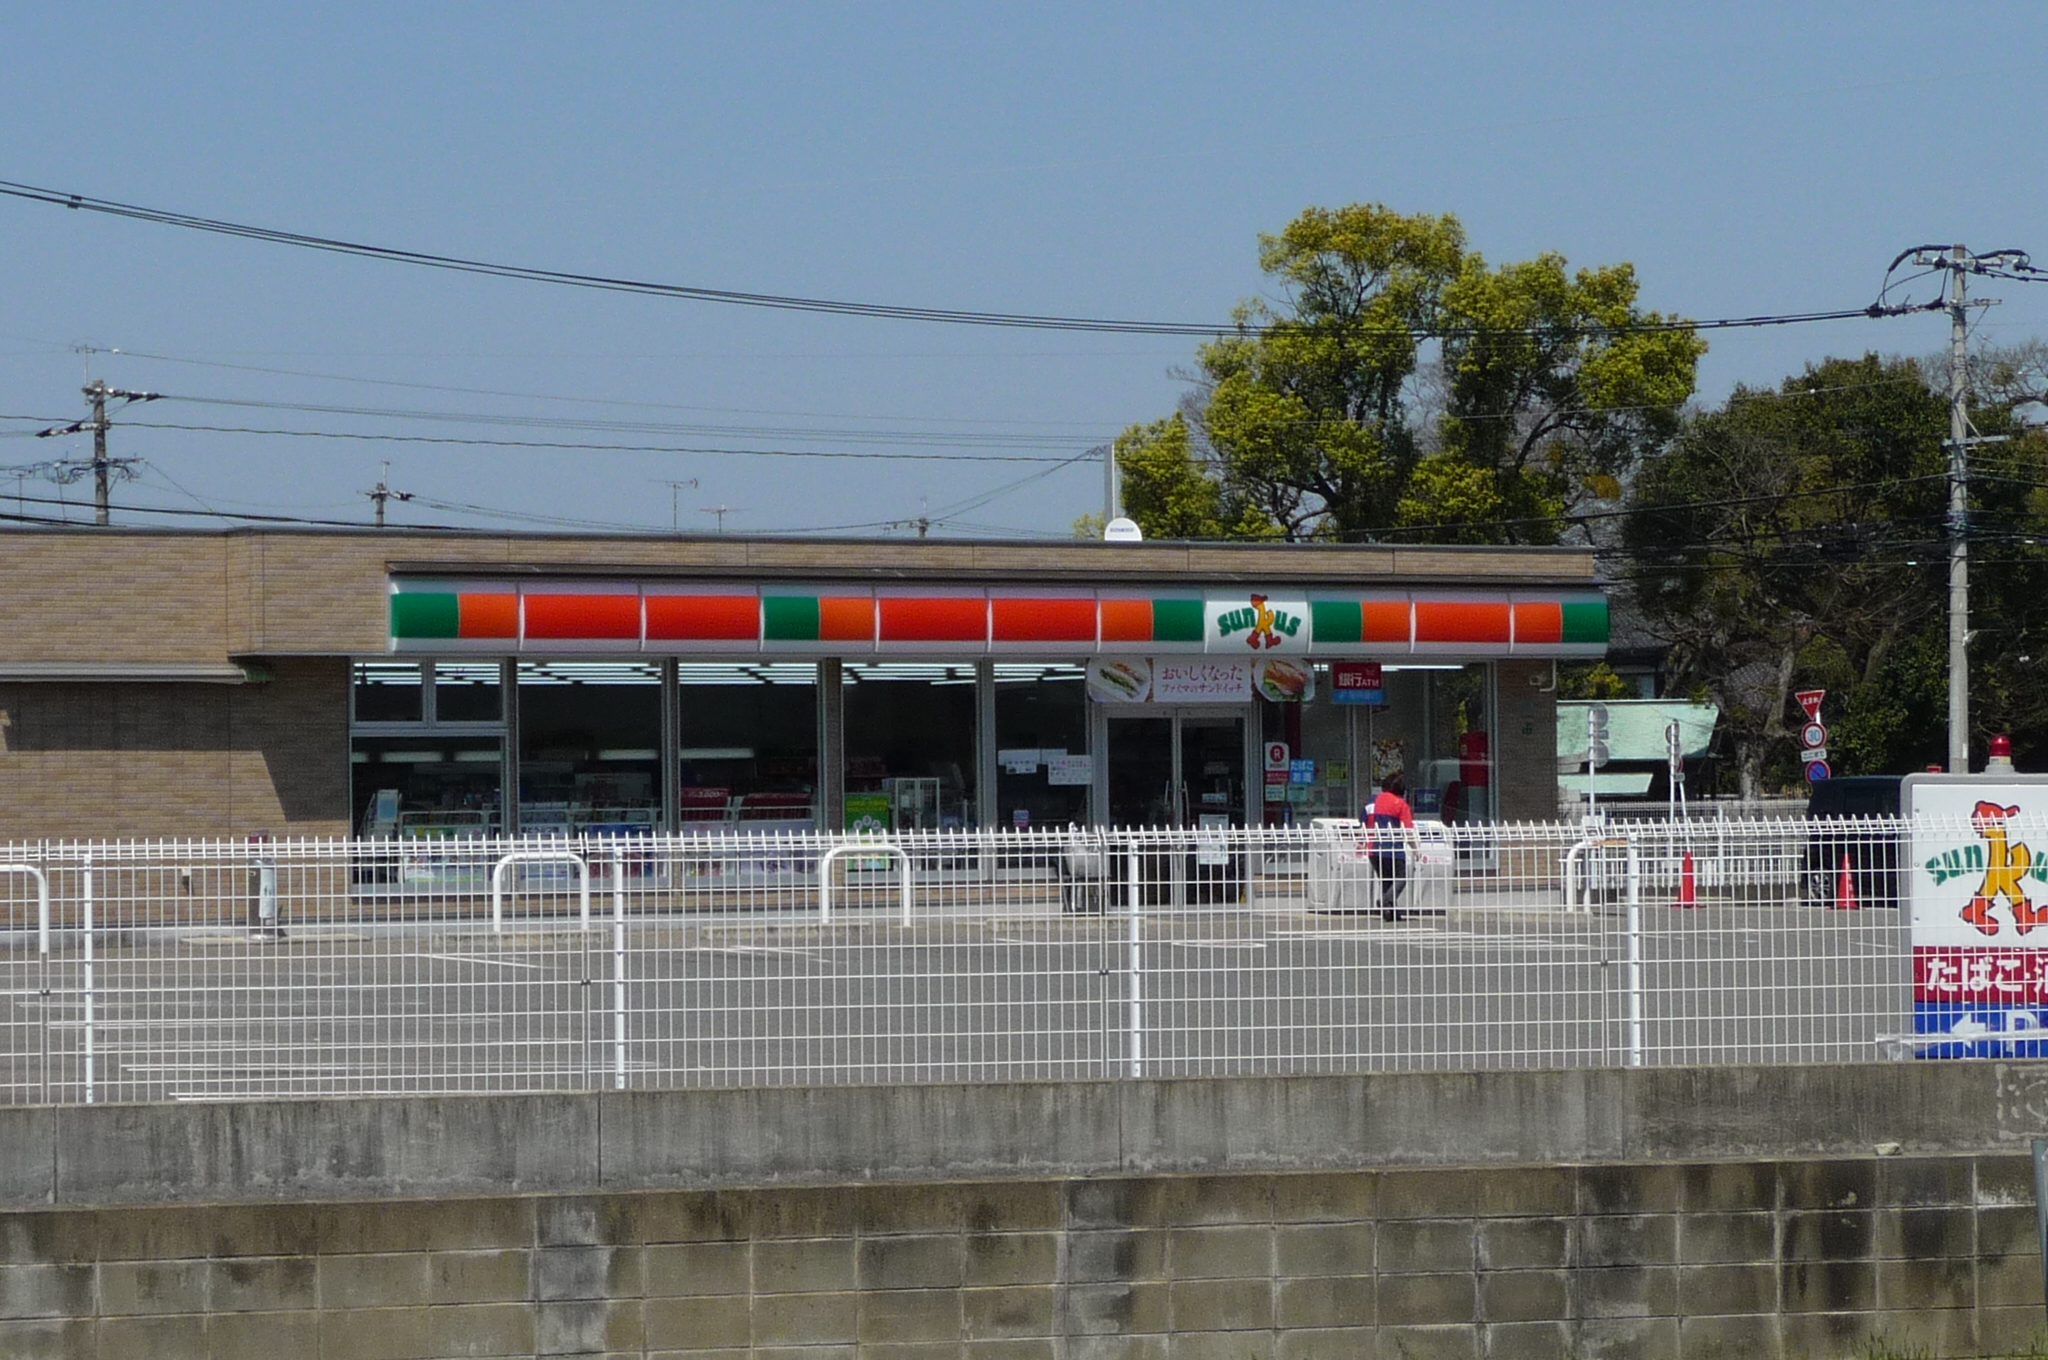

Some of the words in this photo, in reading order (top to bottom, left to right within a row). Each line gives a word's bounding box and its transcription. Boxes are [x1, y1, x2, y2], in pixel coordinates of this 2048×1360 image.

[1161, 664, 1244, 682] おいしくなった
[1161, 682, 1245, 694] ファミマのサンドイッチ
[1807, 730, 1821, 742] 30
